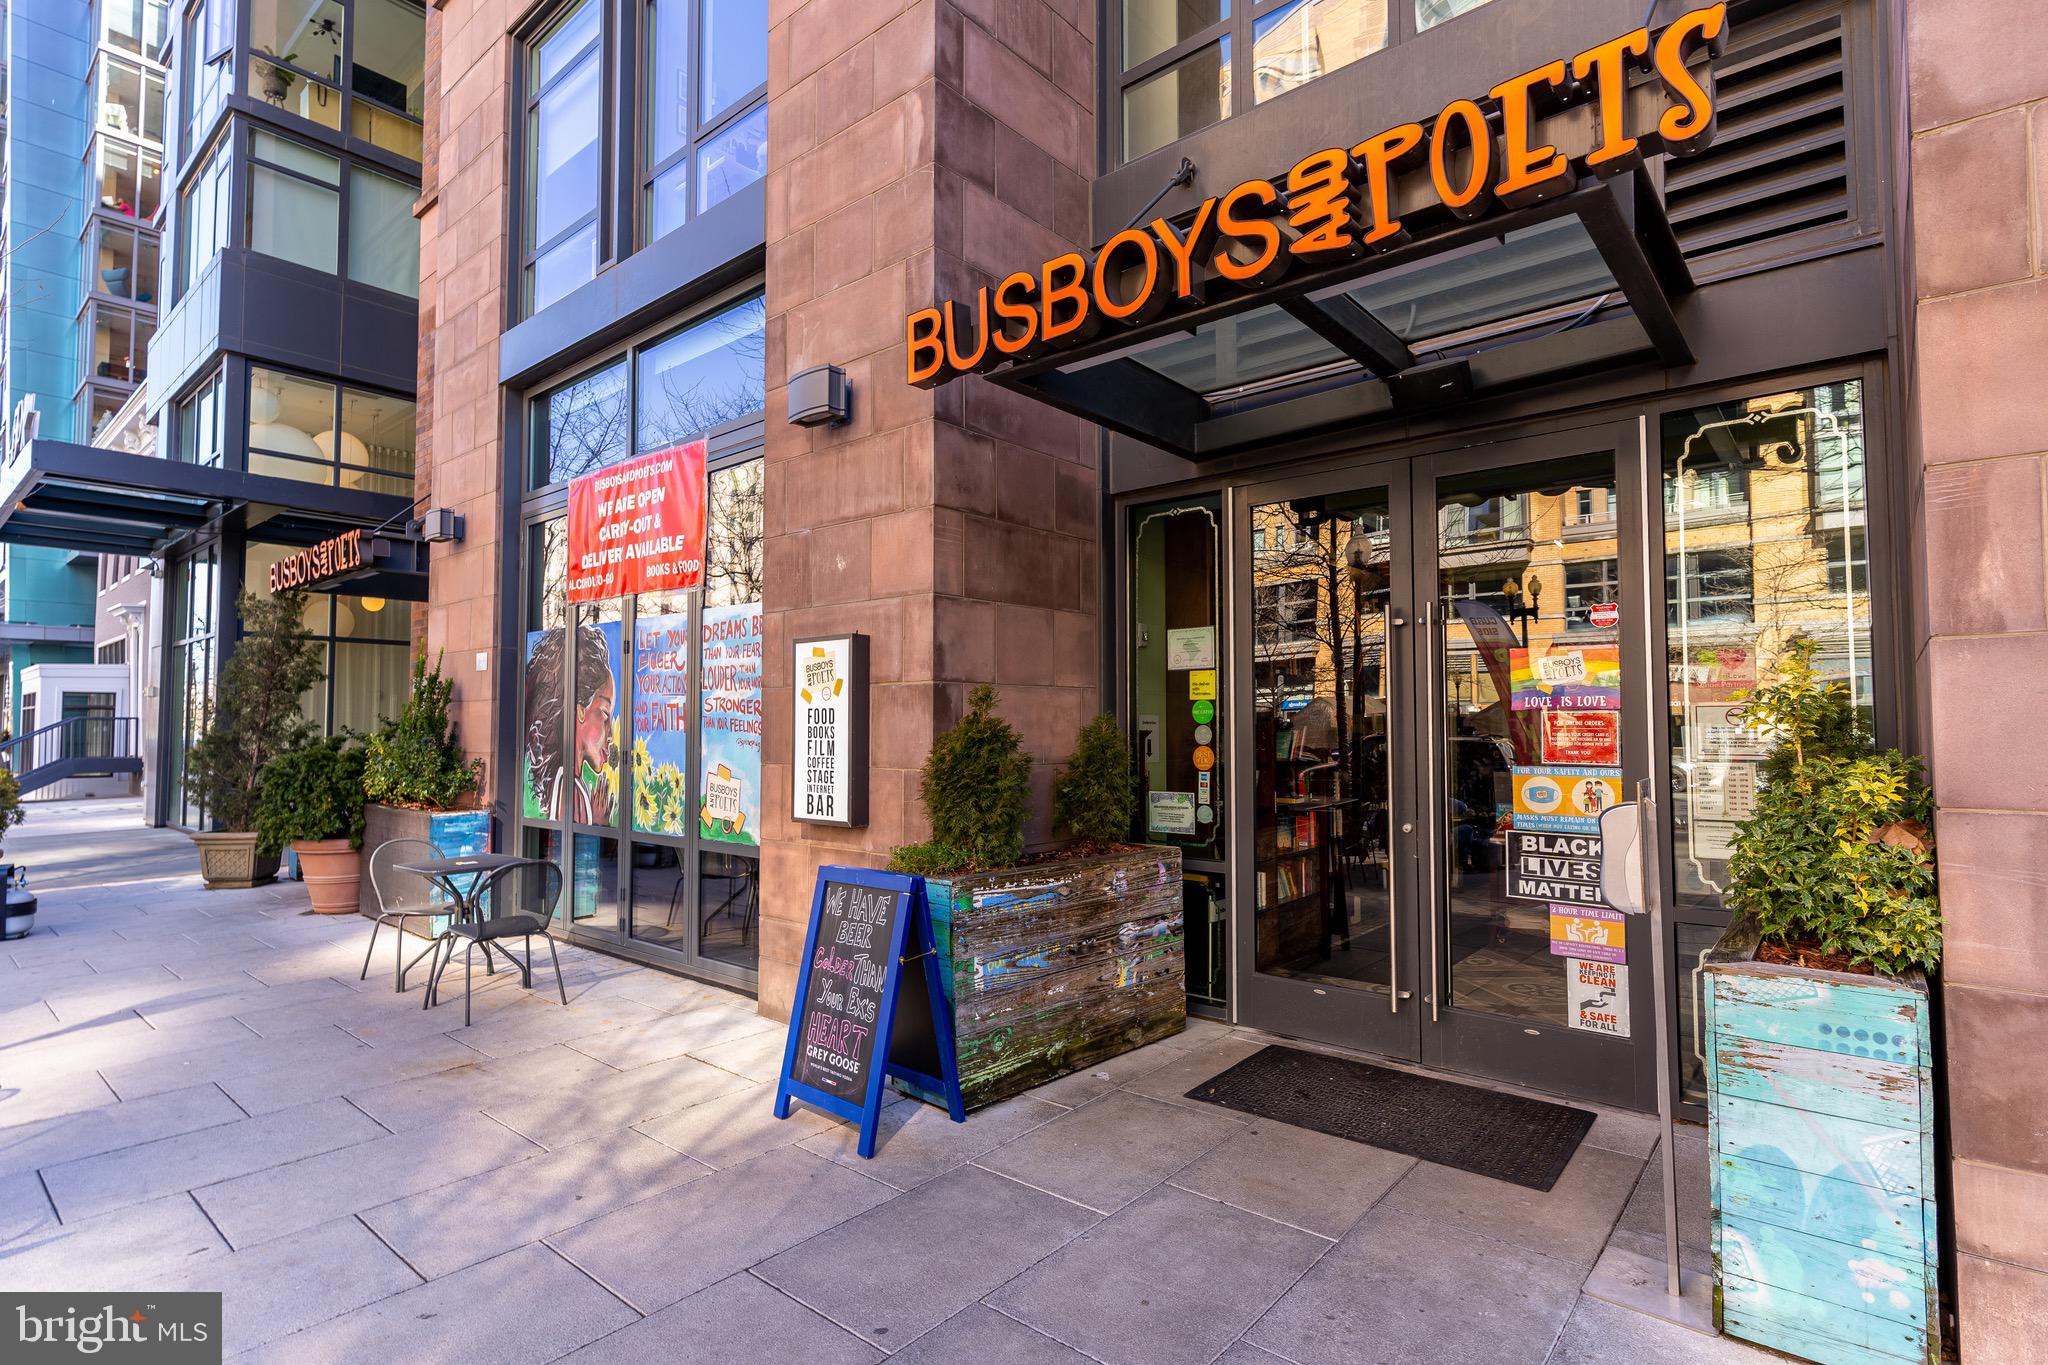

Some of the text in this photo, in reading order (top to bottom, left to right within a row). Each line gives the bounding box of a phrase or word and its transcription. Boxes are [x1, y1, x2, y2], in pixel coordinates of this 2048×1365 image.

[907, 1, 1728, 387] BUSBOYS AND POETS
[598, 486, 666, 518] WE ARE OPEN
[654, 513, 661, 528] &
[625, 535, 685, 560] AVAILABLE
[270, 544, 320, 594] BUSBOYS
[328, 528, 361, 576] POETS
[646, 560, 699, 578] BOOKS & FOOD
[639, 630, 660, 648] LET
[704, 618, 748, 643] DREAMS
[638, 650, 686, 672] BIGGER
[704, 646, 722, 660] THAN
[806, 660, 834, 673] BUSBOYS
[636, 674, 661, 695] YOUR
[702, 662, 756, 692] LOUDER THAN
[812, 669, 834, 686] POETS
[704, 697, 762, 717] STRONGER
[1524, 695, 1606, 708] LOVE IS LOVE
[635, 701, 686, 733] AND FAITH
[636, 717, 650, 732] YOUR
[807, 708, 835, 725] FOOD
[703, 716, 715, 728] THAN
[730, 718, 762, 736] FEELINGS
[807, 726, 835, 740] BOOKS
[807, 740, 835, 756] FILM
[807, 756, 835, 770] COFFEE
[807, 769, 835, 784] STAGE
[710, 782, 738, 798] BUSBOYS
[807, 784, 835, 794] INTERNET
[715, 794, 737, 814] POETS
[807, 794, 835, 816] BAR
[1521, 835, 1602, 856] BLACK
[1522, 858, 1601, 881] LIVES
[826, 886, 892, 926] WE HAVE
[1559, 907, 1578, 915] HOUR
[1581, 910, 1599, 918] TIME
[1602, 912, 1622, 920] LIMIT
[836, 920, 872, 948] BEER
[854, 954, 888, 993] THAN
[1579, 962, 1615, 974] WE ARE
[1580, 970, 1608, 978] KEEPING
[1579, 975, 1616, 988] CLEAN
[1580, 1010, 1617, 1024] & SAFE
[1580, 1019, 1618, 1032] FOR ALL
[808, 1010, 868, 1060] HEART
[807, 1045, 860, 1074] GREY GOOSE
